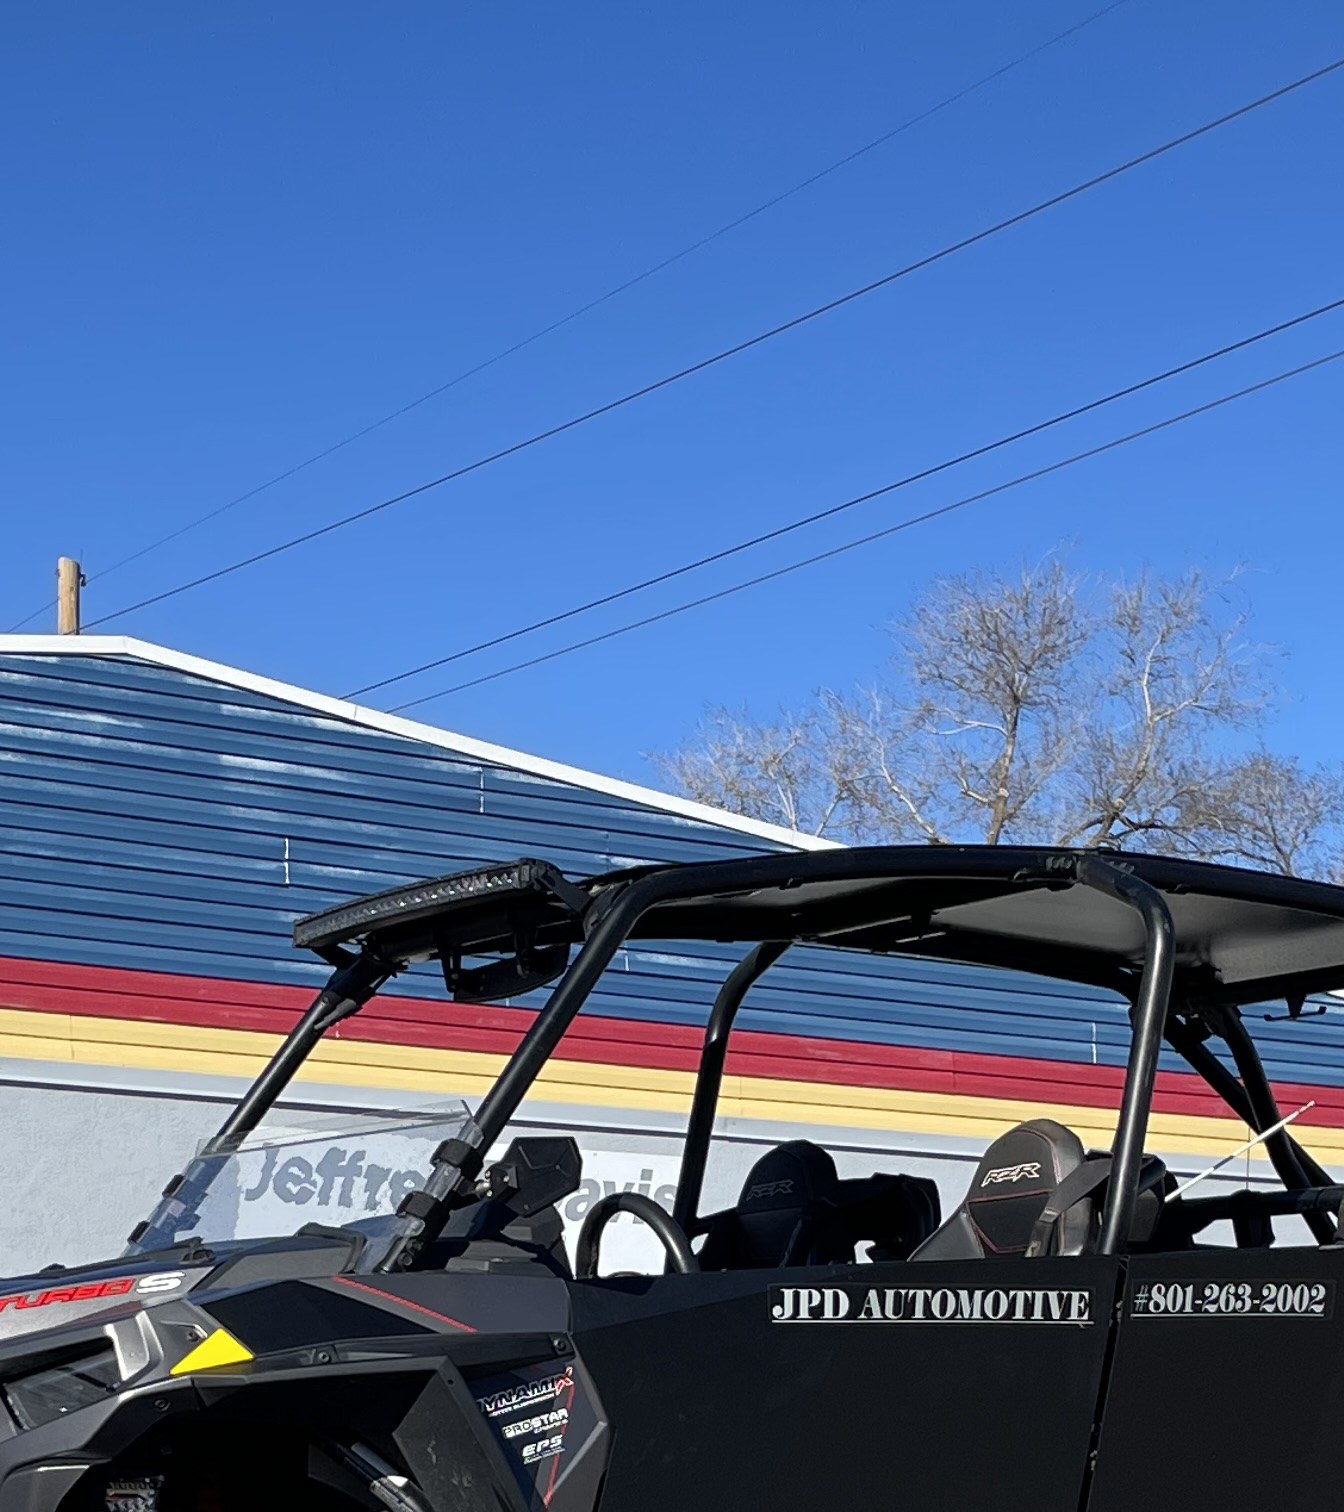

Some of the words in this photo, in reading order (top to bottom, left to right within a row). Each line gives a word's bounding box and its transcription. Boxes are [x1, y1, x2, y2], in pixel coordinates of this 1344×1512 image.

[244, 1145, 429, 1212] Jeffre
[564, 1168, 679, 1224] avis
[981, 1162, 1041, 1188] RZR
[136, 1271, 185, 1294] S
[772, 1288, 849, 1320] JPD
[858, 1288, 1090, 1320] AUTOMOTIVE
[1134, 1283, 1326, 1313] #801-263-2002
[502, 1408, 568, 1439] PROSTAR
[522, 1434, 564, 1457] EPS
